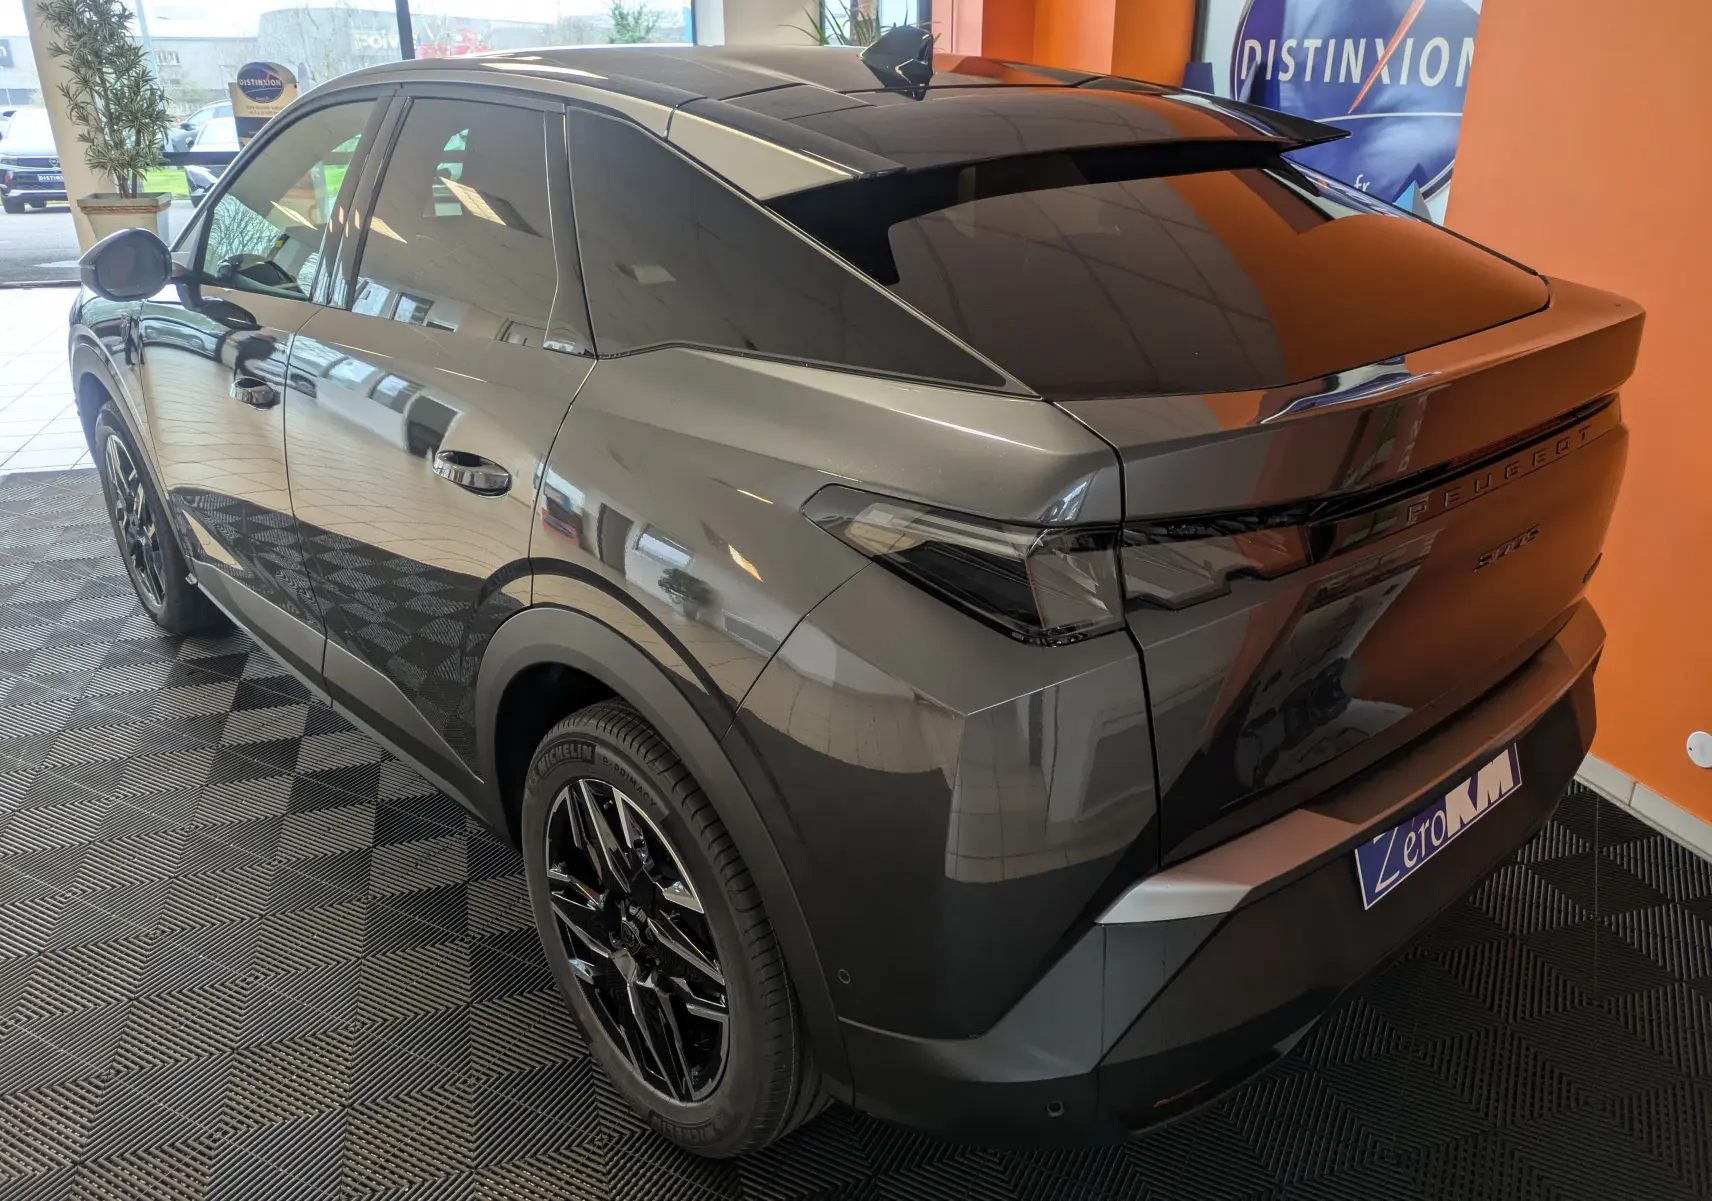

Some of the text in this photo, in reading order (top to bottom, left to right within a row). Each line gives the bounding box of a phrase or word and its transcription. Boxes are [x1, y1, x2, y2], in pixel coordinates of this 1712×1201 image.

[1241, 36, 1475, 87] DISTINXION
[240, 78, 281, 86] DISTINXION
[1407, 425, 1591, 523] PEUGEOT
[536, 743, 592, 772] MICHELIN
